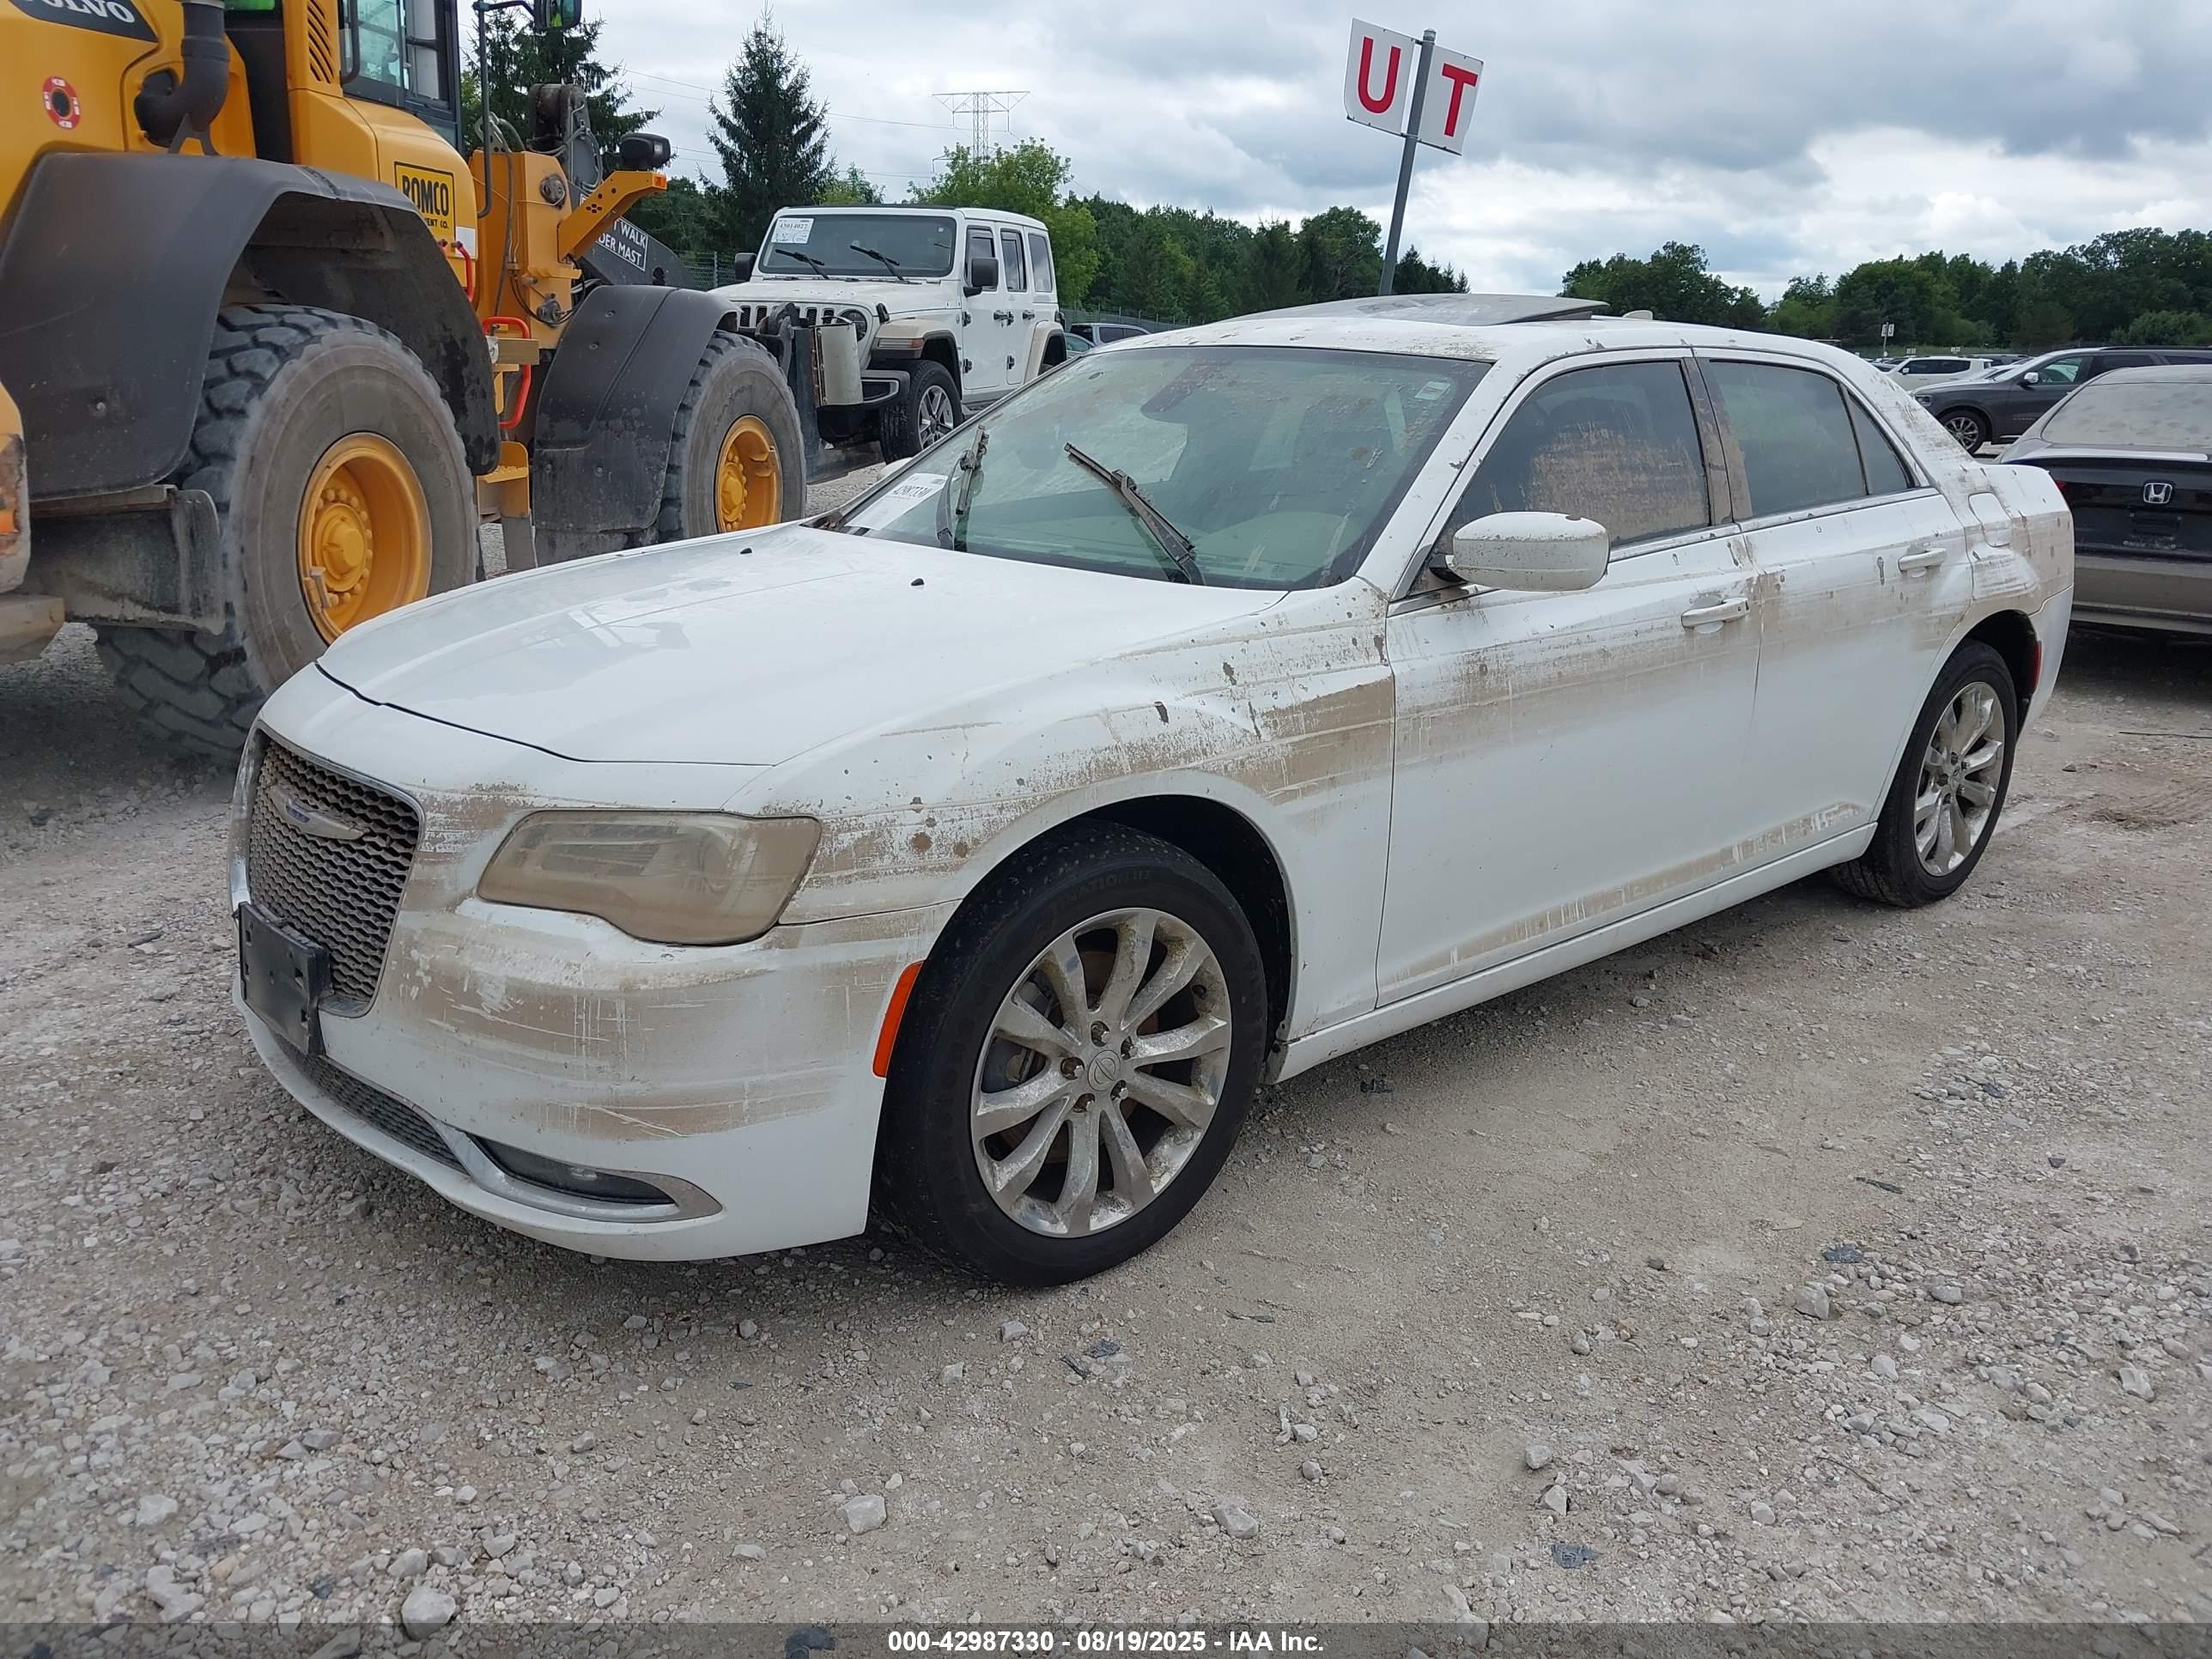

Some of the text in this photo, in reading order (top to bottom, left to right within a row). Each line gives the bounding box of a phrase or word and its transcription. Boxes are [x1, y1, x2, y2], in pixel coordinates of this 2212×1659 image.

[1358, 36, 1479, 137] U T
[598, 233, 642, 265] DER MAST
[620, 222, 646, 248] WALK
